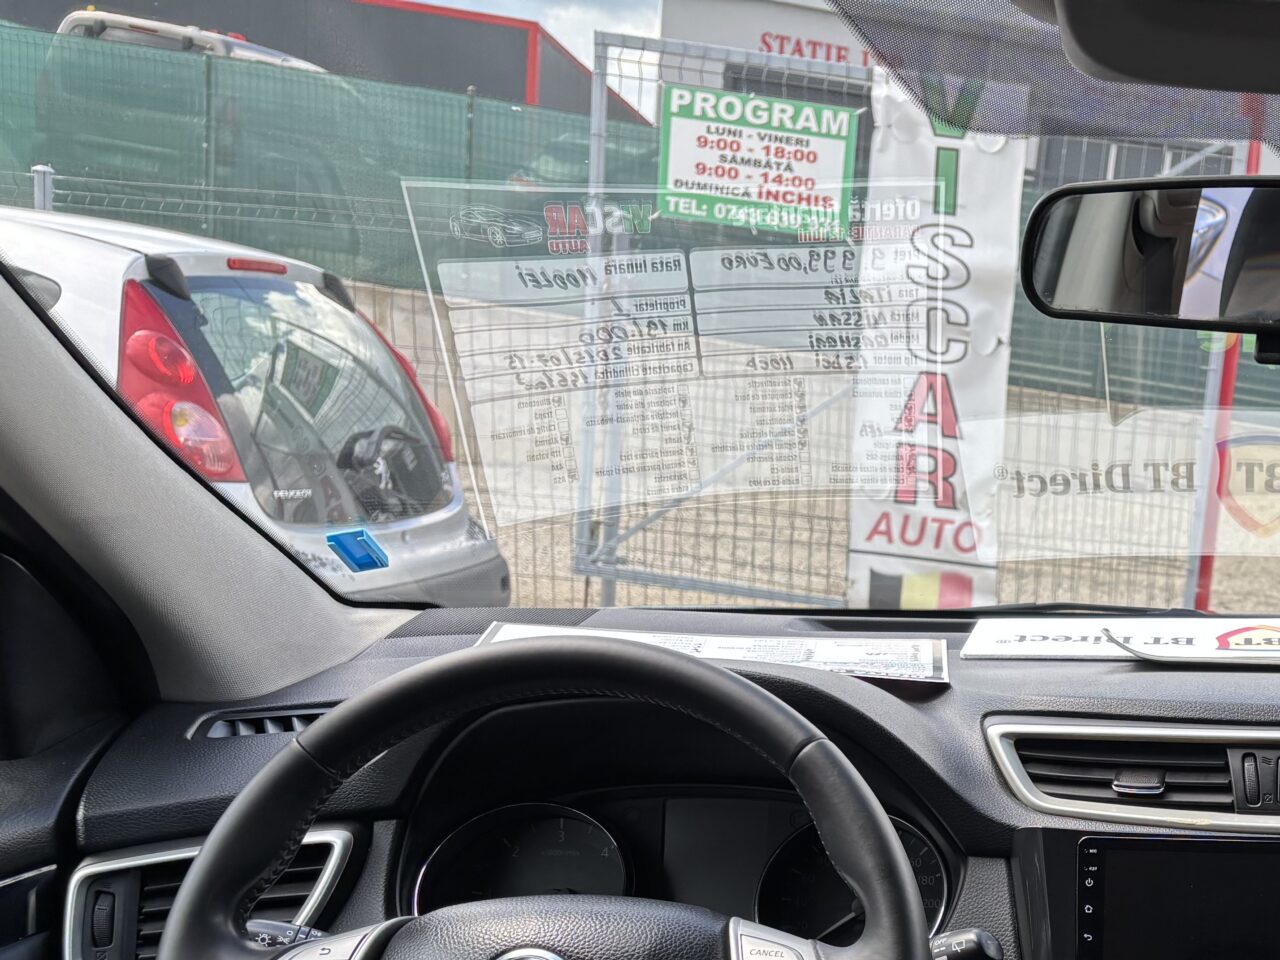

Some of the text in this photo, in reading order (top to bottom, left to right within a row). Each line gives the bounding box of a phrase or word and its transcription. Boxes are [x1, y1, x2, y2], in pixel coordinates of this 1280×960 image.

[669, 87, 850, 137] PROGRAM
[705, 124, 811, 148] LUNI VINERI
[695, 135, 818, 164] 9:00 18:00
[694, 162, 816, 191] 9:00 14:00
[666, 196, 708, 217] TEL:
[866, 510, 981, 555] AUTO
[558, 830, 565, 842] 3
[749, 949, 784, 958] CANCEL
